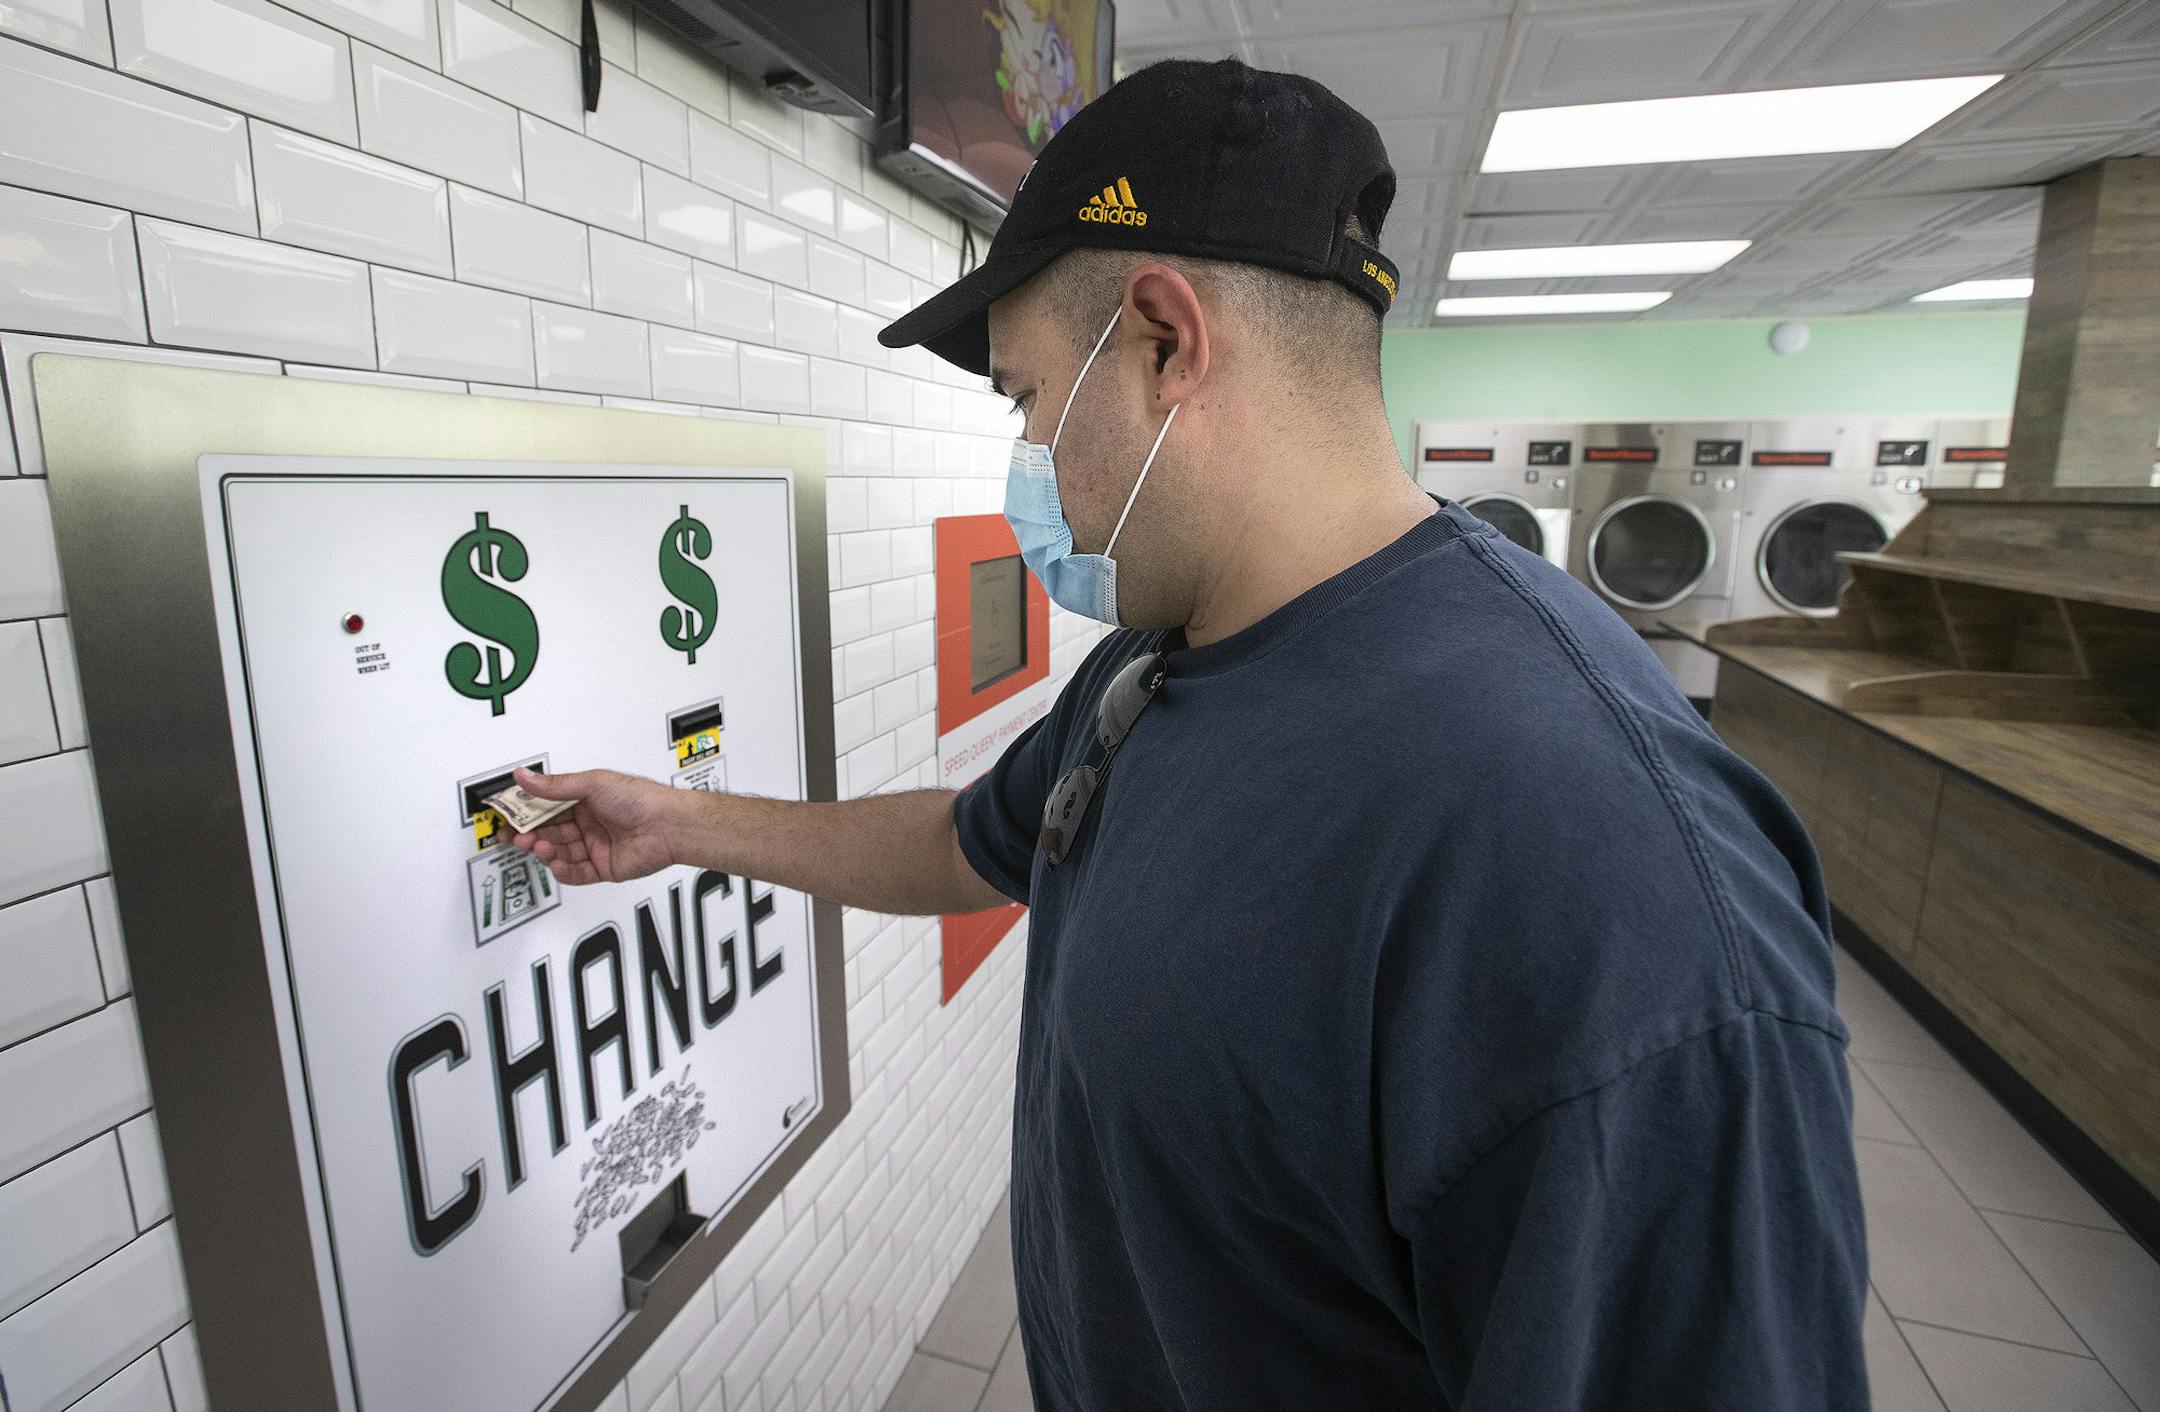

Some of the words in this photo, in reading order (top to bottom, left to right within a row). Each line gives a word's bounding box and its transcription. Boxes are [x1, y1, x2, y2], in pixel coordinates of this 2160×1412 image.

[1079, 203, 1148, 226] adidas
[1363, 258, 1377, 277] LOS
[355, 645, 369, 653] OUT
[371, 643, 381, 651] OF
[356, 653, 385, 663] SERVICE
[358, 665, 377, 674] WHEN
[944, 750, 969, 778] SPEED
[998, 711, 1026, 738] PAYMENT
[387, 868, 785, 1257] CHANGE
